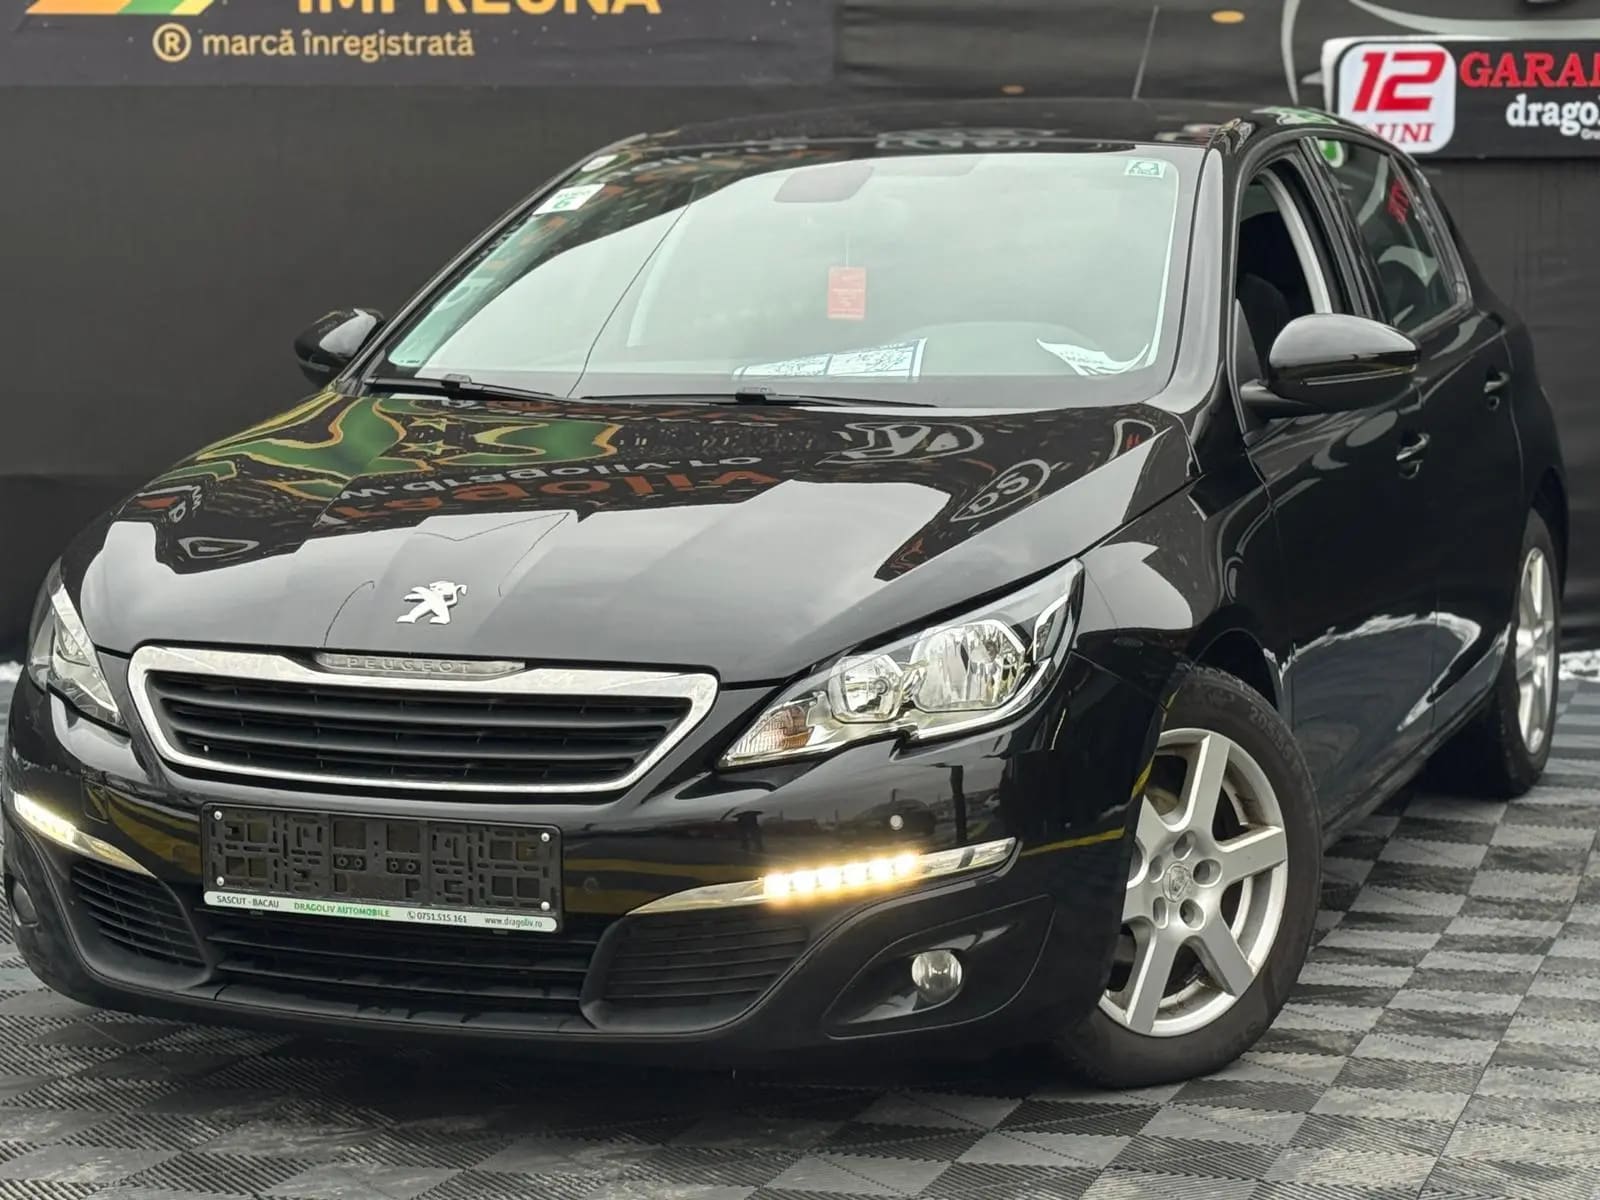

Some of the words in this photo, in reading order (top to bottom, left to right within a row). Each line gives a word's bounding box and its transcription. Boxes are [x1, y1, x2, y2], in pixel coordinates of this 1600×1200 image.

[203, 29, 296, 56] marcă
[302, 29, 475, 62] înregistrată
[1353, 51, 1447, 112] 12
[1506, 92, 1600, 136] drago
[346, 656, 471, 674] PEUGEOT
[216, 895, 246, 906] SASCUT
[294, 902, 335, 913] DRAGOLIV
[336, 905, 391, 918] AUTOMOBILE
